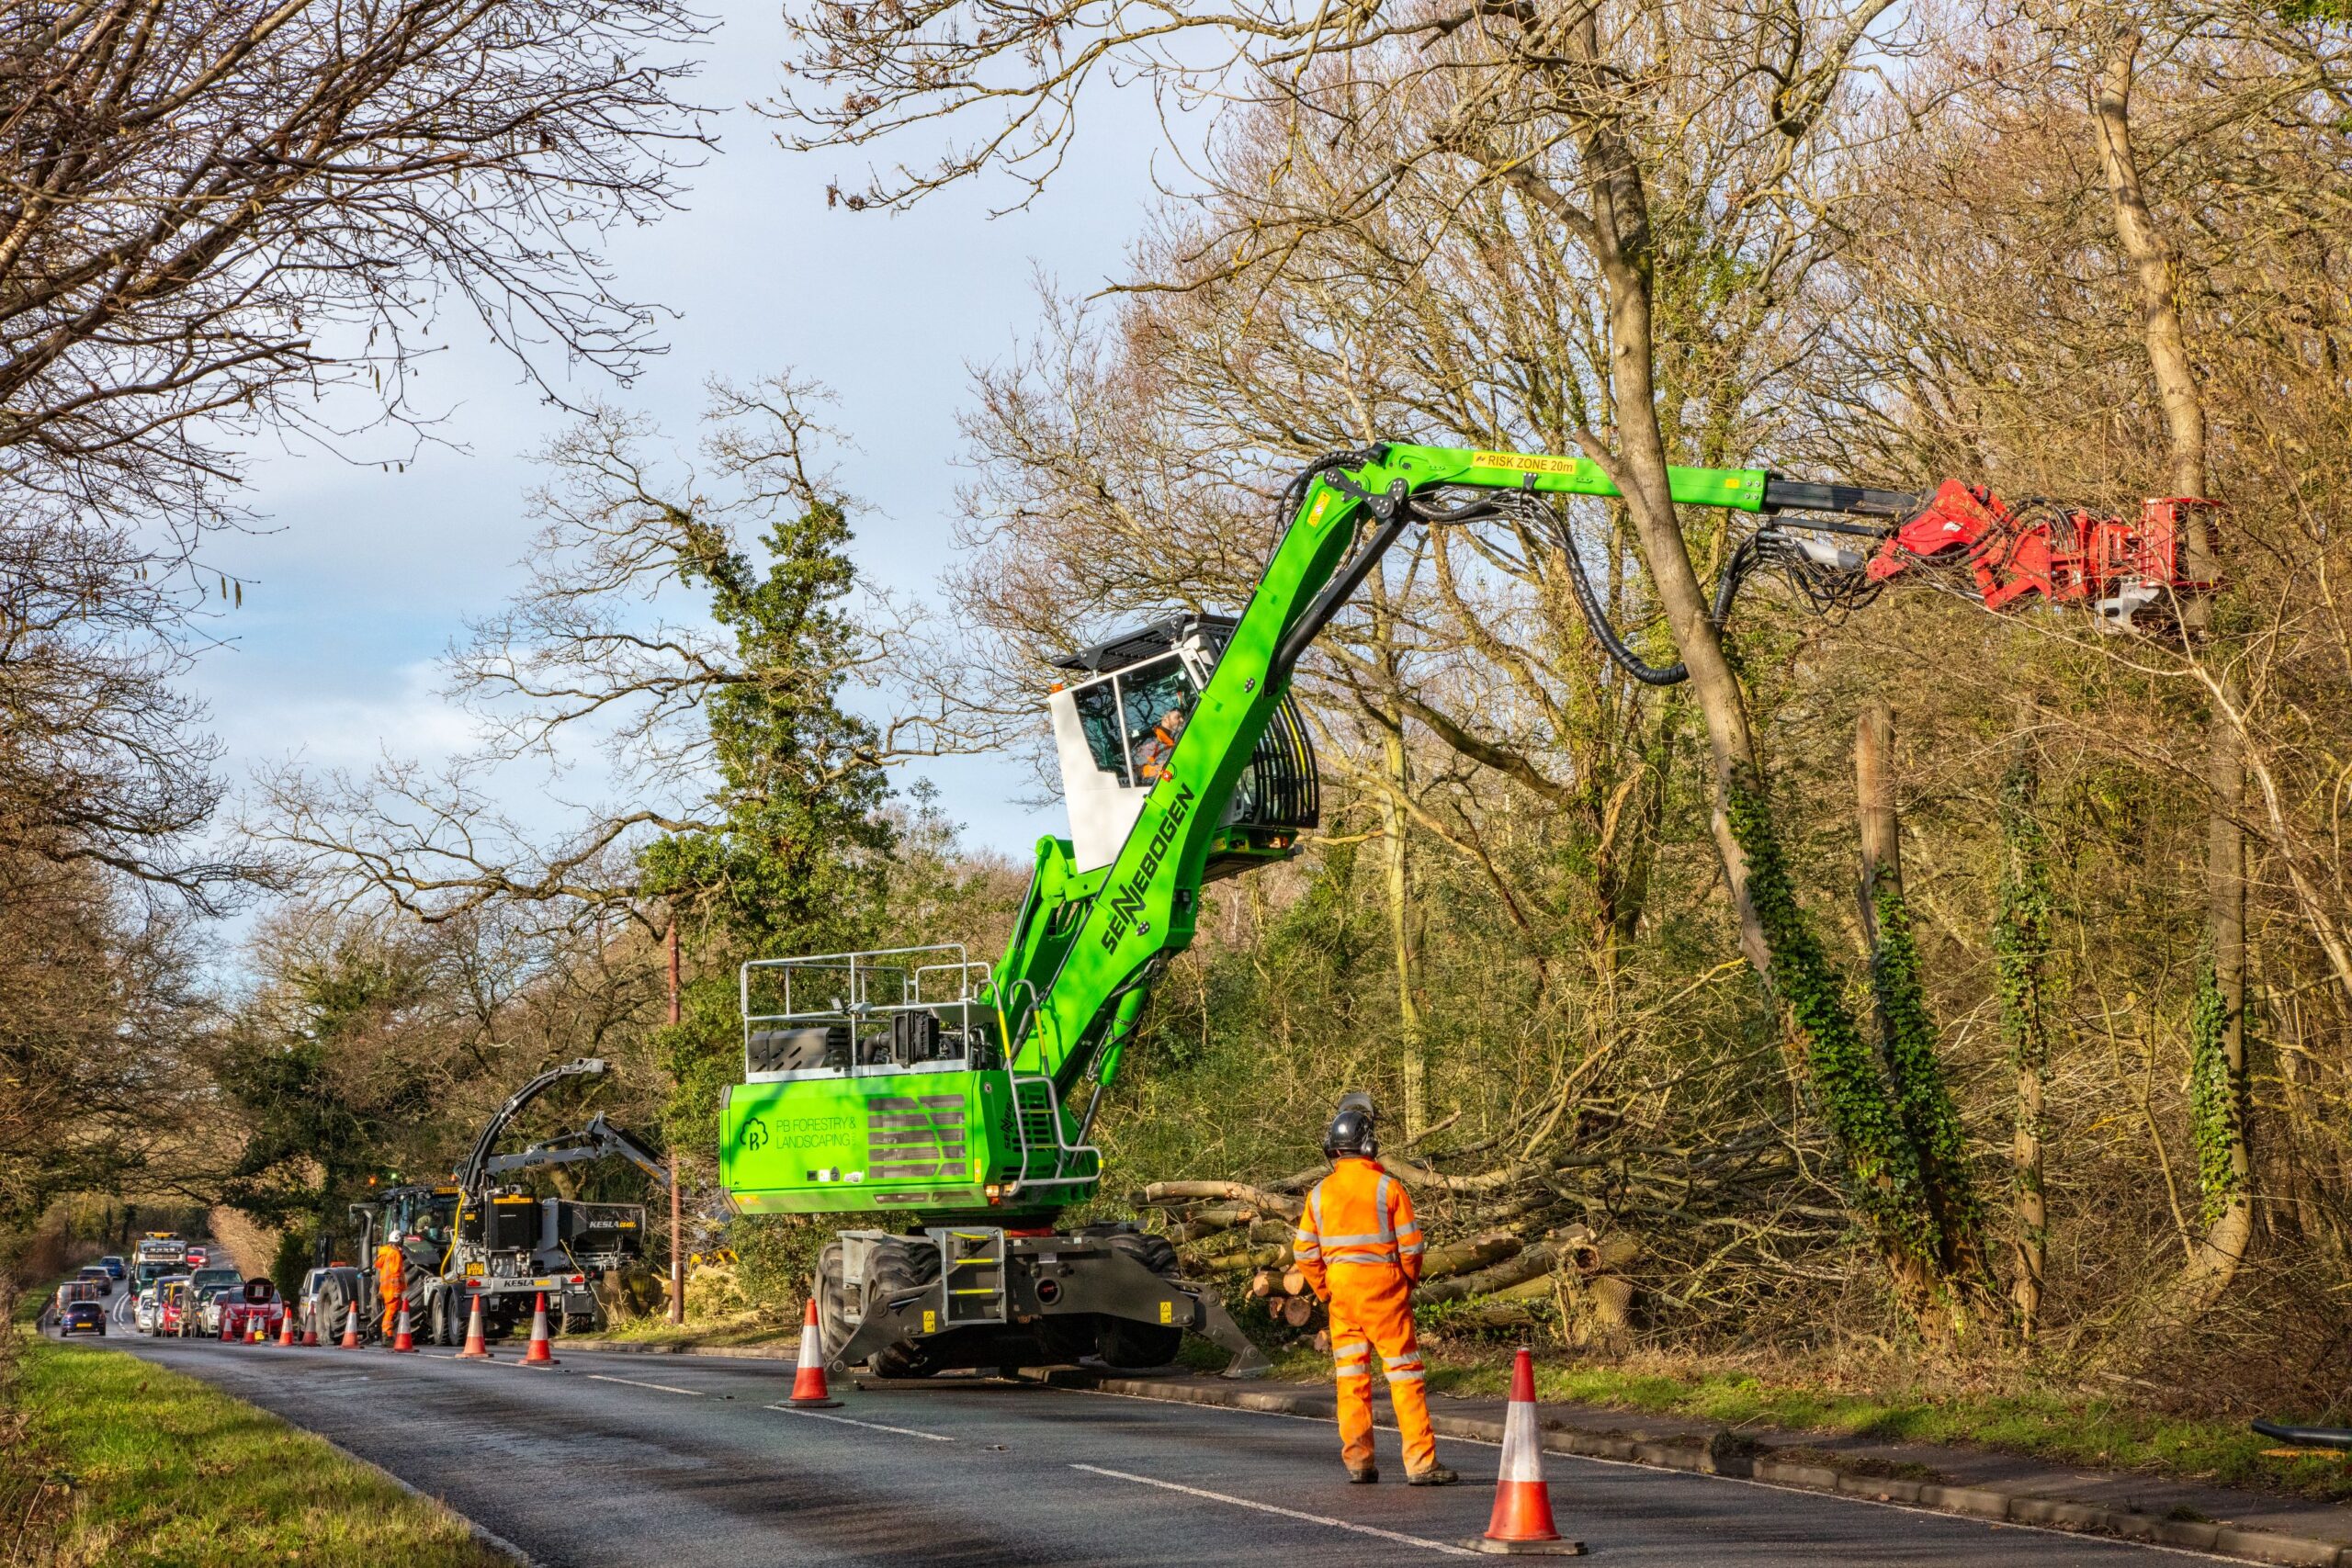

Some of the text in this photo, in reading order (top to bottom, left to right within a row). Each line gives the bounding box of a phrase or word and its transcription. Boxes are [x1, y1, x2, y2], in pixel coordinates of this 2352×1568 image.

[1488, 455, 1573, 472] RISK ZONE 20m
[1102, 783, 1195, 955] SENNEBOGEN
[776, 1116, 856, 1133] PB FORESTRY &
[776, 1133, 851, 1149] LANDSCAPING
[525, 1158, 545, 1167] KESLA
[589, 1220, 619, 1228] KESLA
[503, 1279, 534, 1287] KESLA
